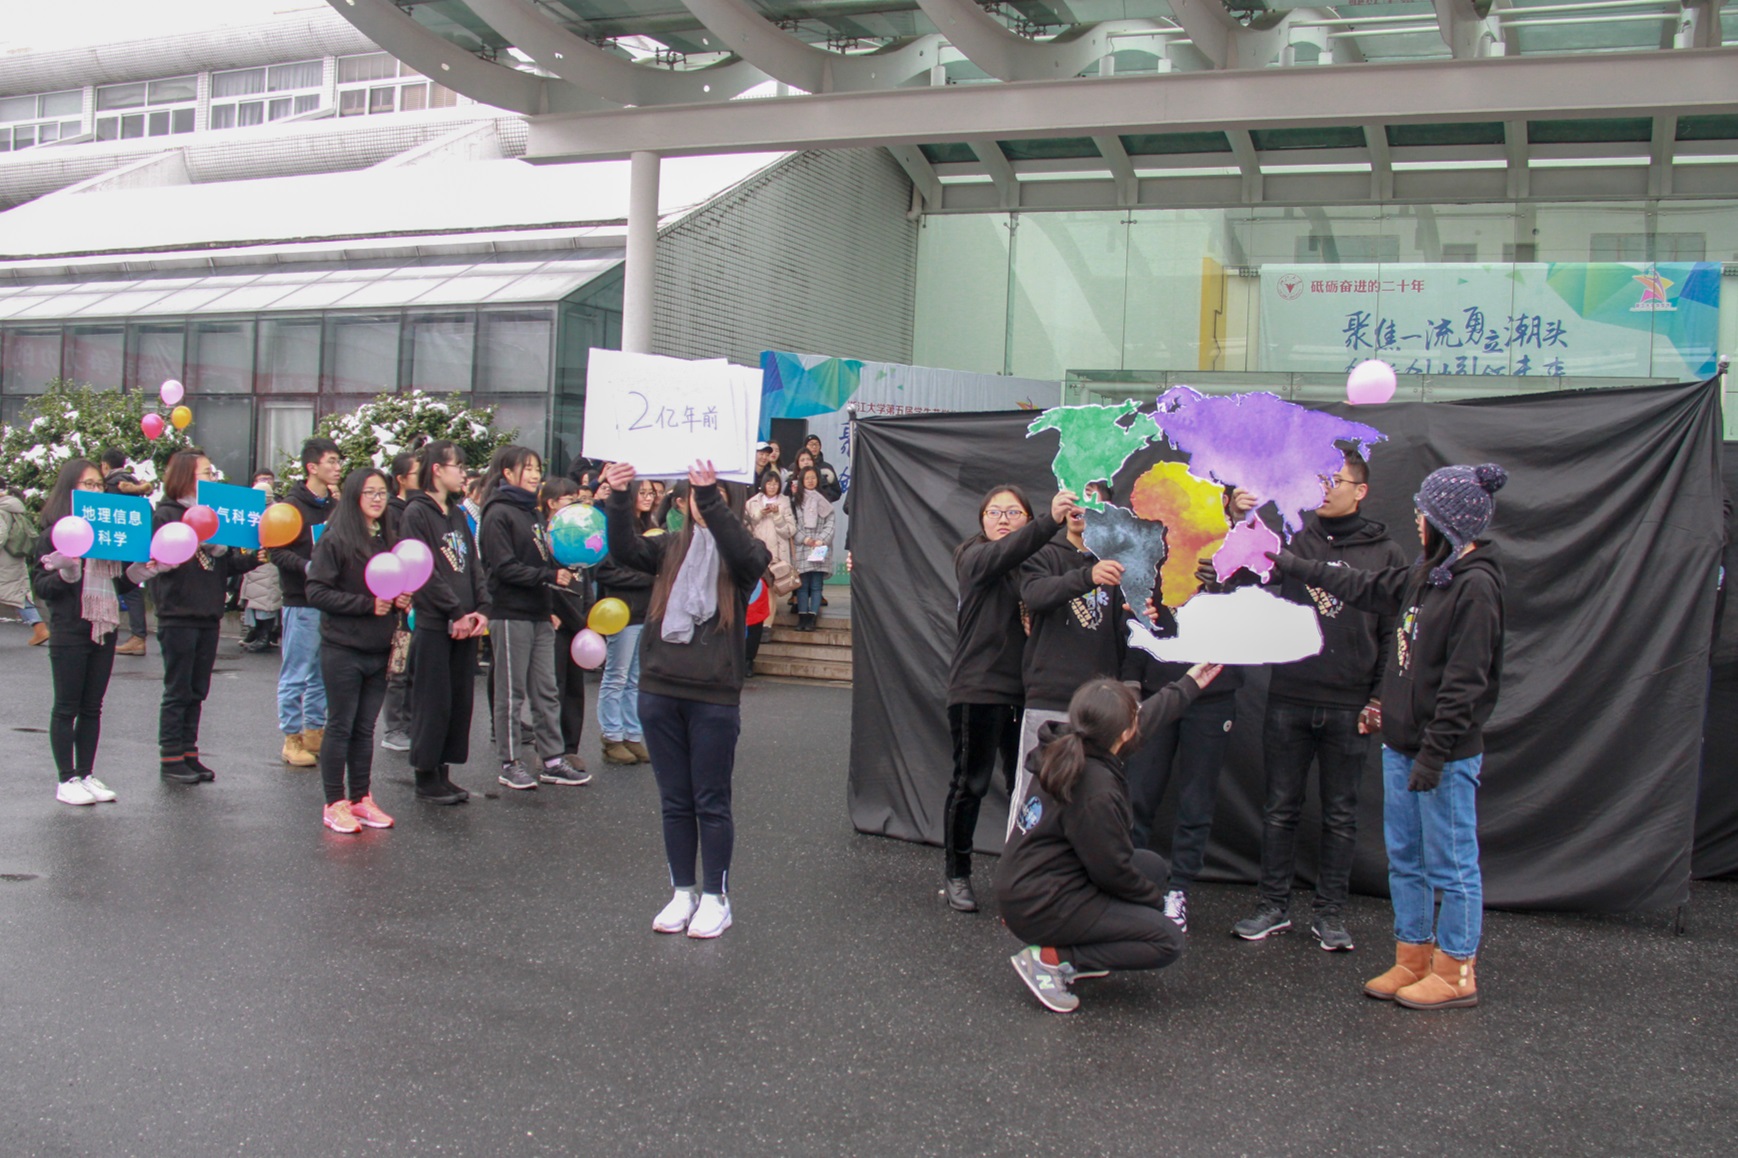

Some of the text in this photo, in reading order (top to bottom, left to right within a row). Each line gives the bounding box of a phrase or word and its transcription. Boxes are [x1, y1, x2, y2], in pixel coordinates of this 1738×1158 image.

[1311, 280, 1425, 293] 砥砺奋进的二十年
[628, 391, 719, 433] 2亿年前
[82, 505, 142, 526] 地理信息
[207, 504, 261, 527] 气科学
[98, 530, 127, 547] 科学
[1036, 975, 1055, 990] N
